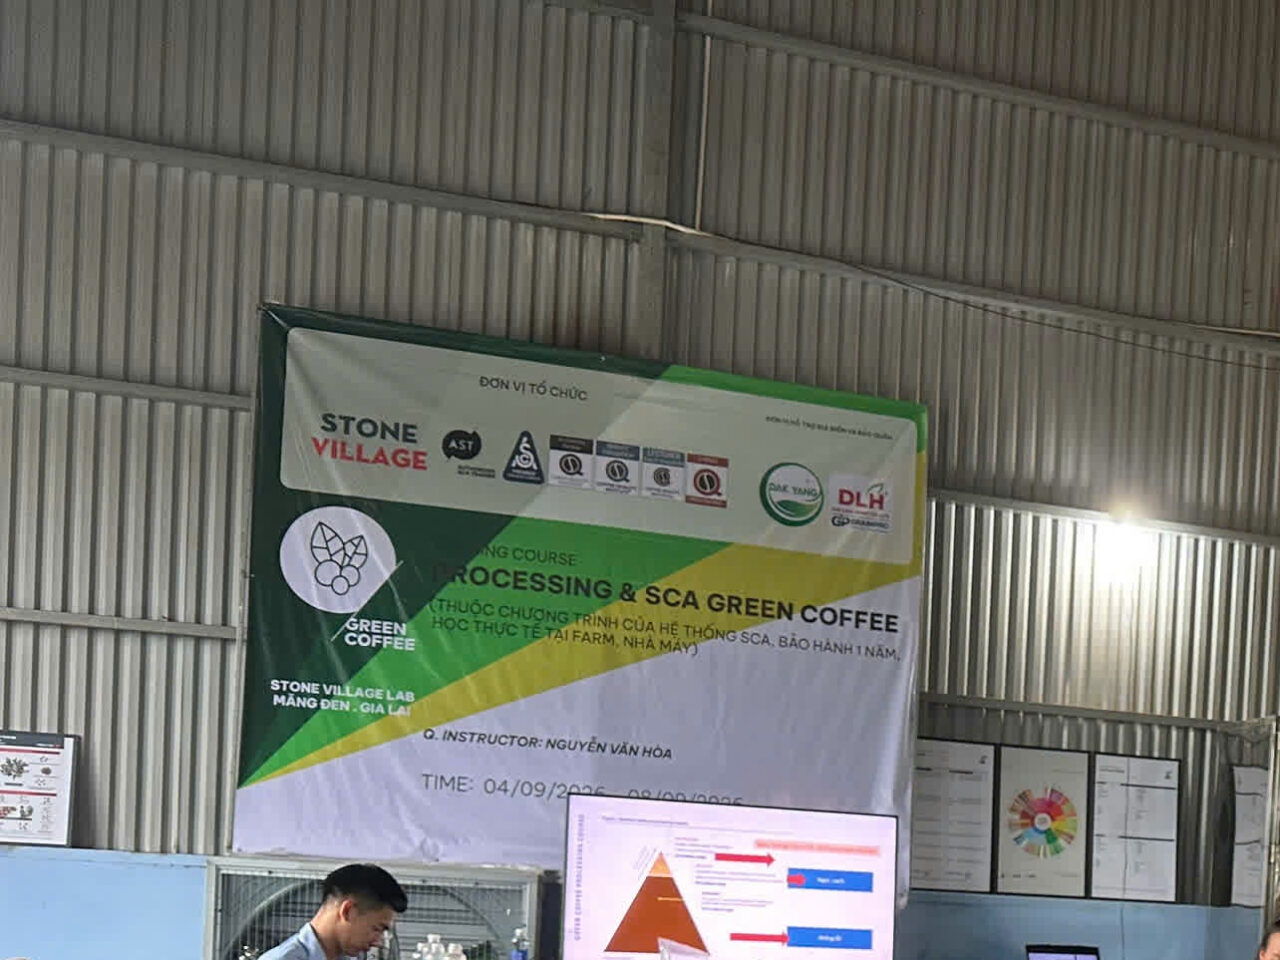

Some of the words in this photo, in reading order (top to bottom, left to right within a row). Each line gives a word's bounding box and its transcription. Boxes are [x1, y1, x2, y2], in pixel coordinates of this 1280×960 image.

[479, 376, 509, 390] ĐƠN
[513, 381, 526, 394] VỊ
[320, 413, 418, 444] STONE
[311, 437, 428, 471] VILLAGE
[448, 440, 475, 452] AST
[838, 488, 885, 510] DLH
[512, 547, 578, 567] COURSE
[619, 582, 637, 603] &
[645, 585, 699, 610] SCA
[707, 592, 794, 621] GREEN
[800, 605, 899, 634] COFFEE
[345, 618, 407, 636] GREEN
[498, 605, 570, 624] CHƯƠNG
[622, 615, 654, 633] CỦA
[684, 622, 737, 642] THỐNG
[344, 632, 416, 651] COFFEE
[270, 679, 320, 695] STONE
[322, 684, 383, 700] VILLAGE
[386, 690, 415, 703] LAB
[273, 693, 318, 709] MĂNG
[319, 699, 350, 712] ĐEN
[360, 703, 385, 715] GIA
[388, 704, 412, 717] LAI
[423, 728, 439, 741] Q.
[442, 730, 543, 749] INSTRUCTOR:
[545, 736, 607, 753] NGUYỄN
[610, 741, 640, 756] VĂN
[422, 773, 474, 793] TIME:
